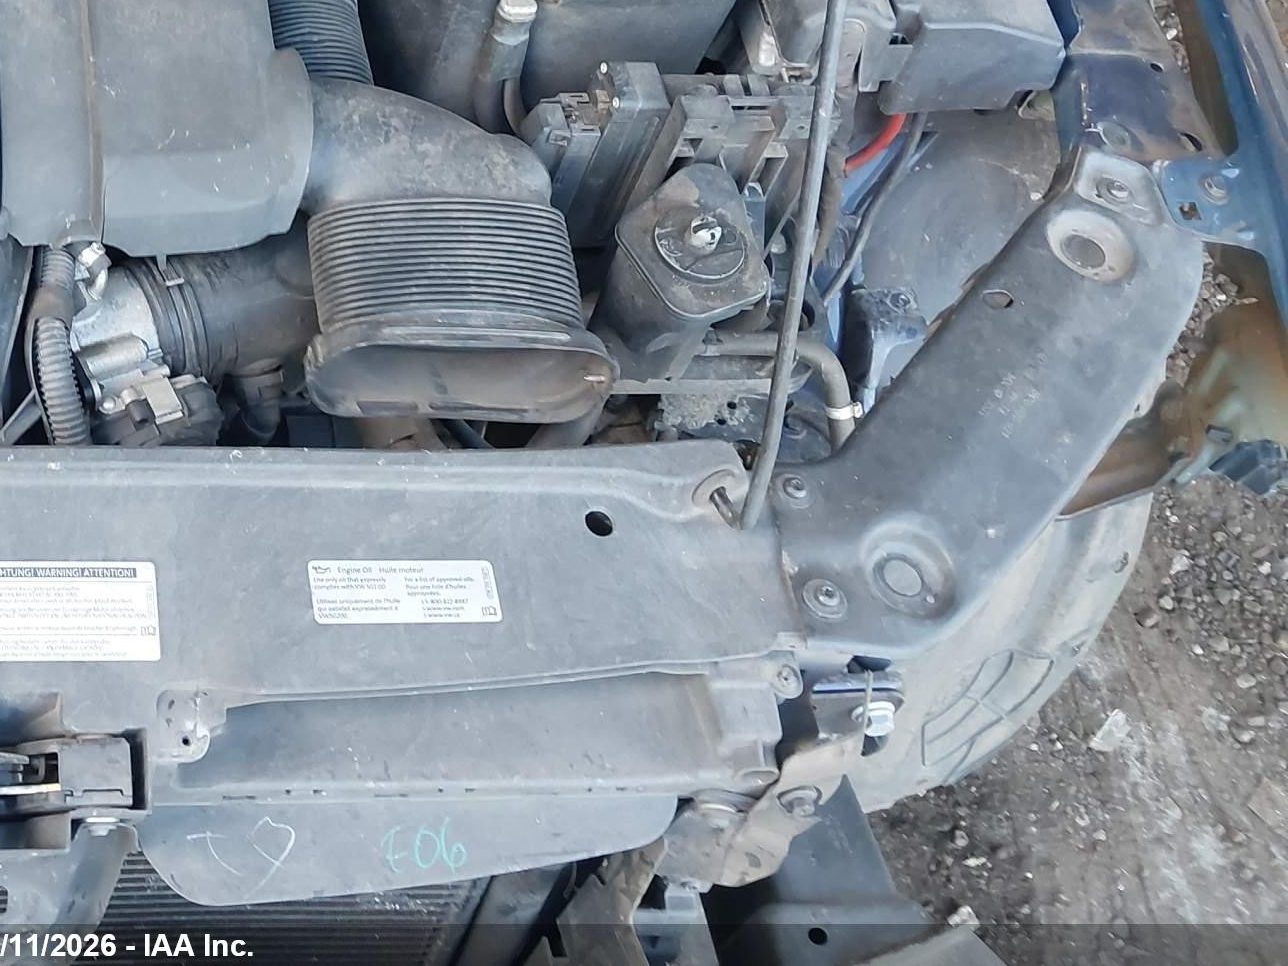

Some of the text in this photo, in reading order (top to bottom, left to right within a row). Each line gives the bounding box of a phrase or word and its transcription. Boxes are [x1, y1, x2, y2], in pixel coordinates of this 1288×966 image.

[37, 568, 81, 578] WARNING!
[83, 568, 134, 578] ATTENTION!
[337, 566, 361, 575] Engine
